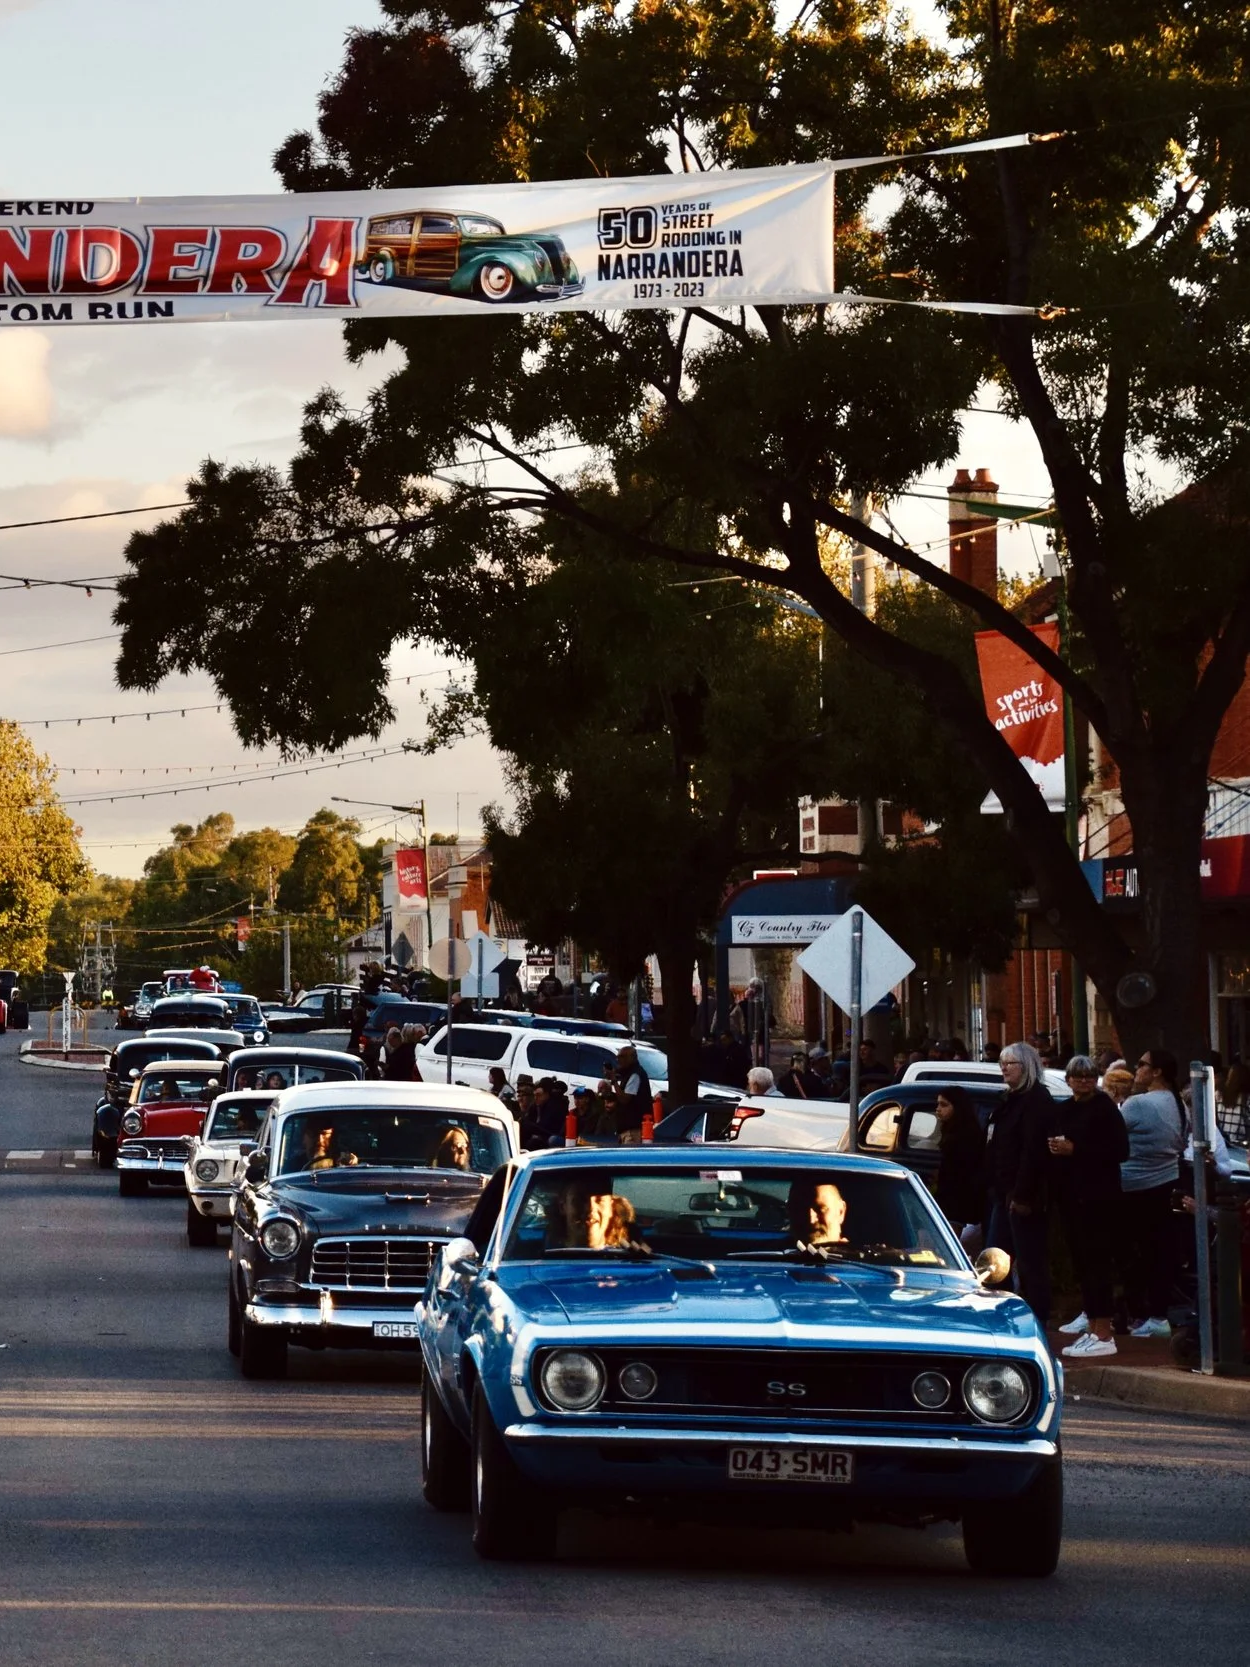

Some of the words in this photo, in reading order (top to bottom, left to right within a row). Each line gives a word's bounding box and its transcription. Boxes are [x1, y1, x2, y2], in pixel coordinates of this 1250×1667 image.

[661, 204, 696, 215] YEARS
[699, 202, 712, 211] OF
[597, 206, 657, 250] 50
[662, 213, 714, 229] STREET
[661, 232, 726, 248] RODDING
[729, 230, 742, 245] IN
[598, 249, 744, 281] NARRANDERA
[634, 284, 661, 298] 1973
[674, 282, 704, 297] 2023
[88, 301, 174, 319] RUN
[996, 680, 1043, 711] sports
[995, 698, 1058, 731] activities
[759, 920, 802, 936] Country
[767, 1381, 807, 1396] SS
